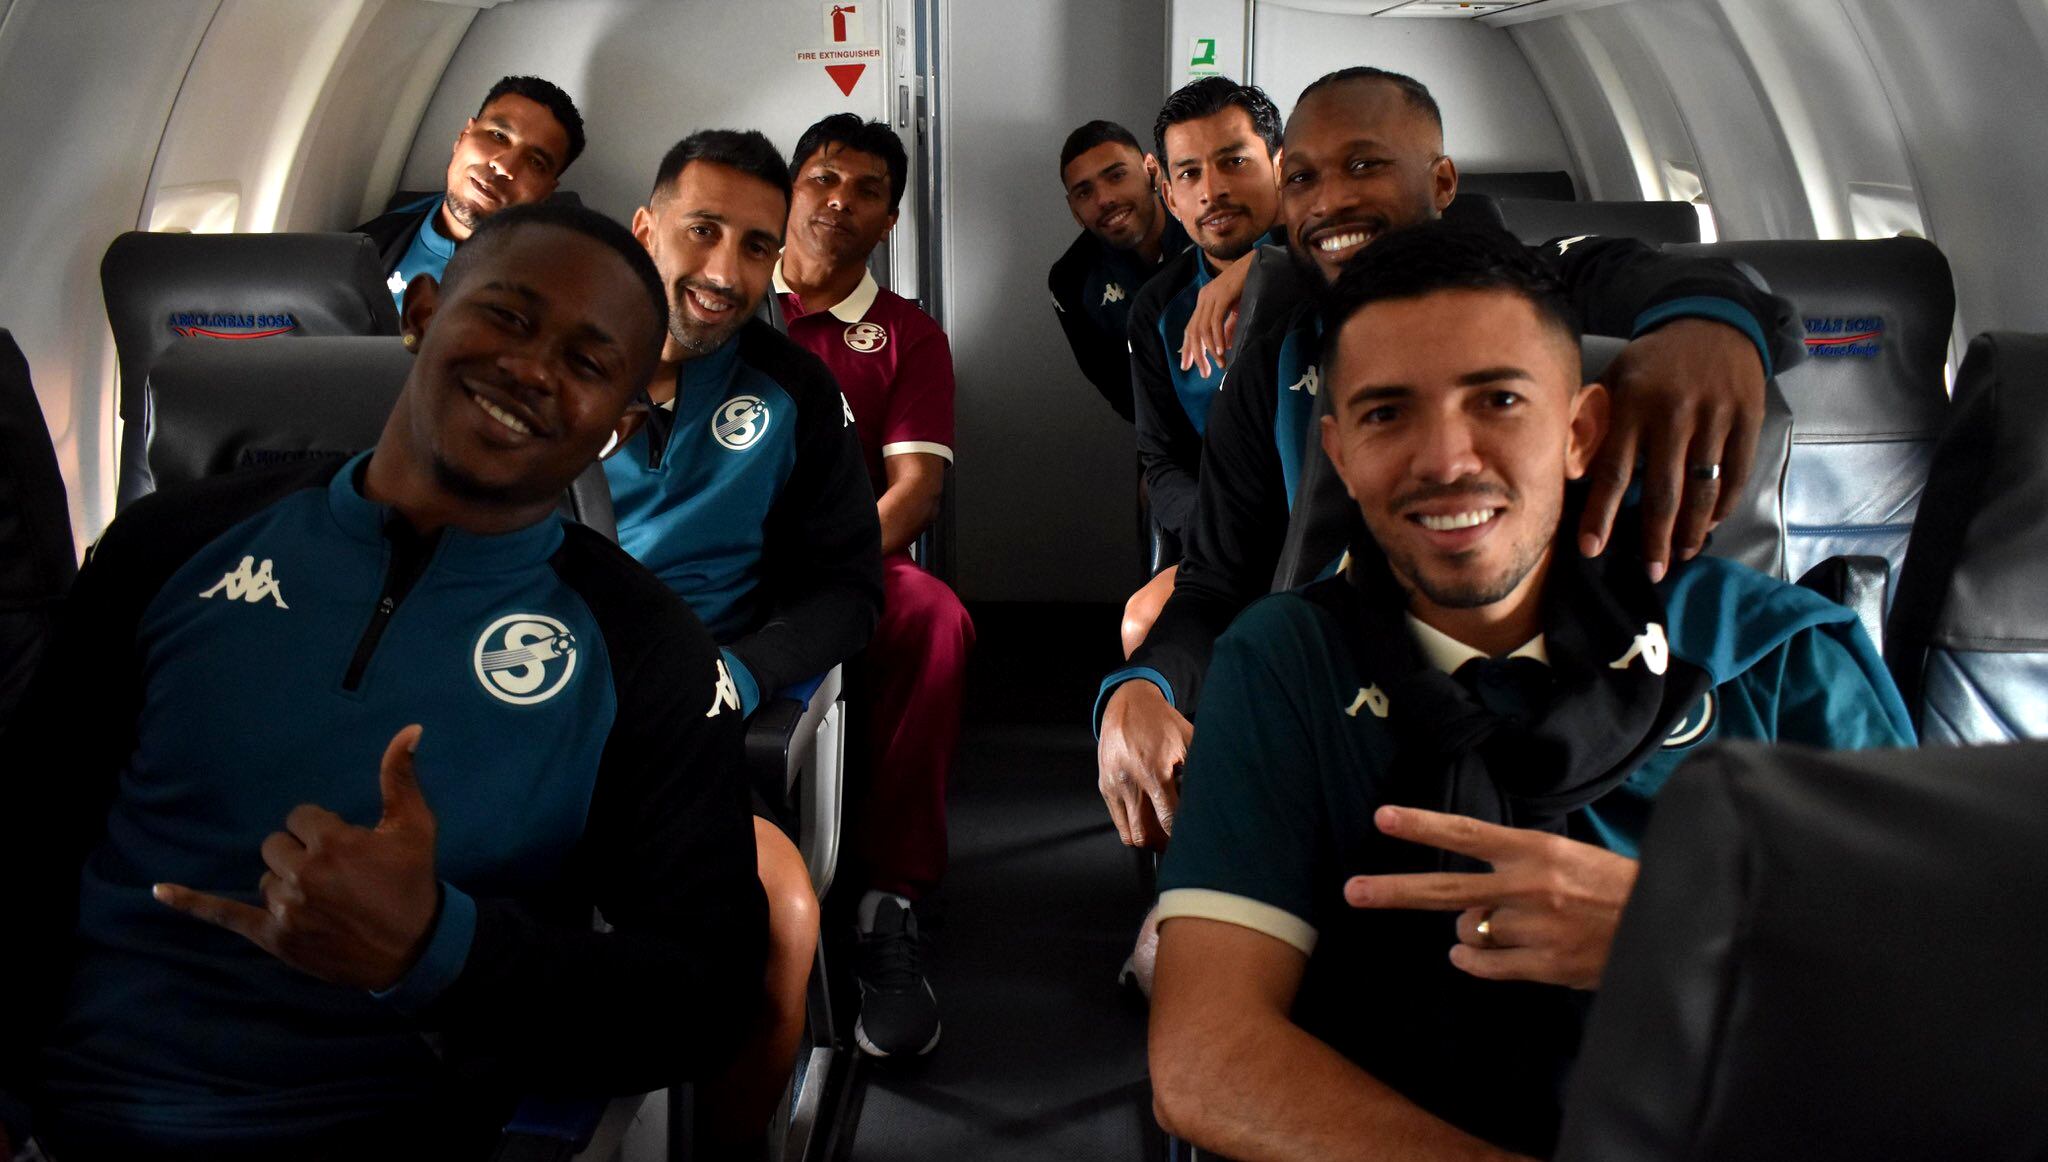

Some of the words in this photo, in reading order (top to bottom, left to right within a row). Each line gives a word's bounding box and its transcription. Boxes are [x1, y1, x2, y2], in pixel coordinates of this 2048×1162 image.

[819, 49, 880, 59] EXTINGUISHER
[168, 312, 255, 328] AEROLINEAS
[257, 312, 296, 328] SOSA
